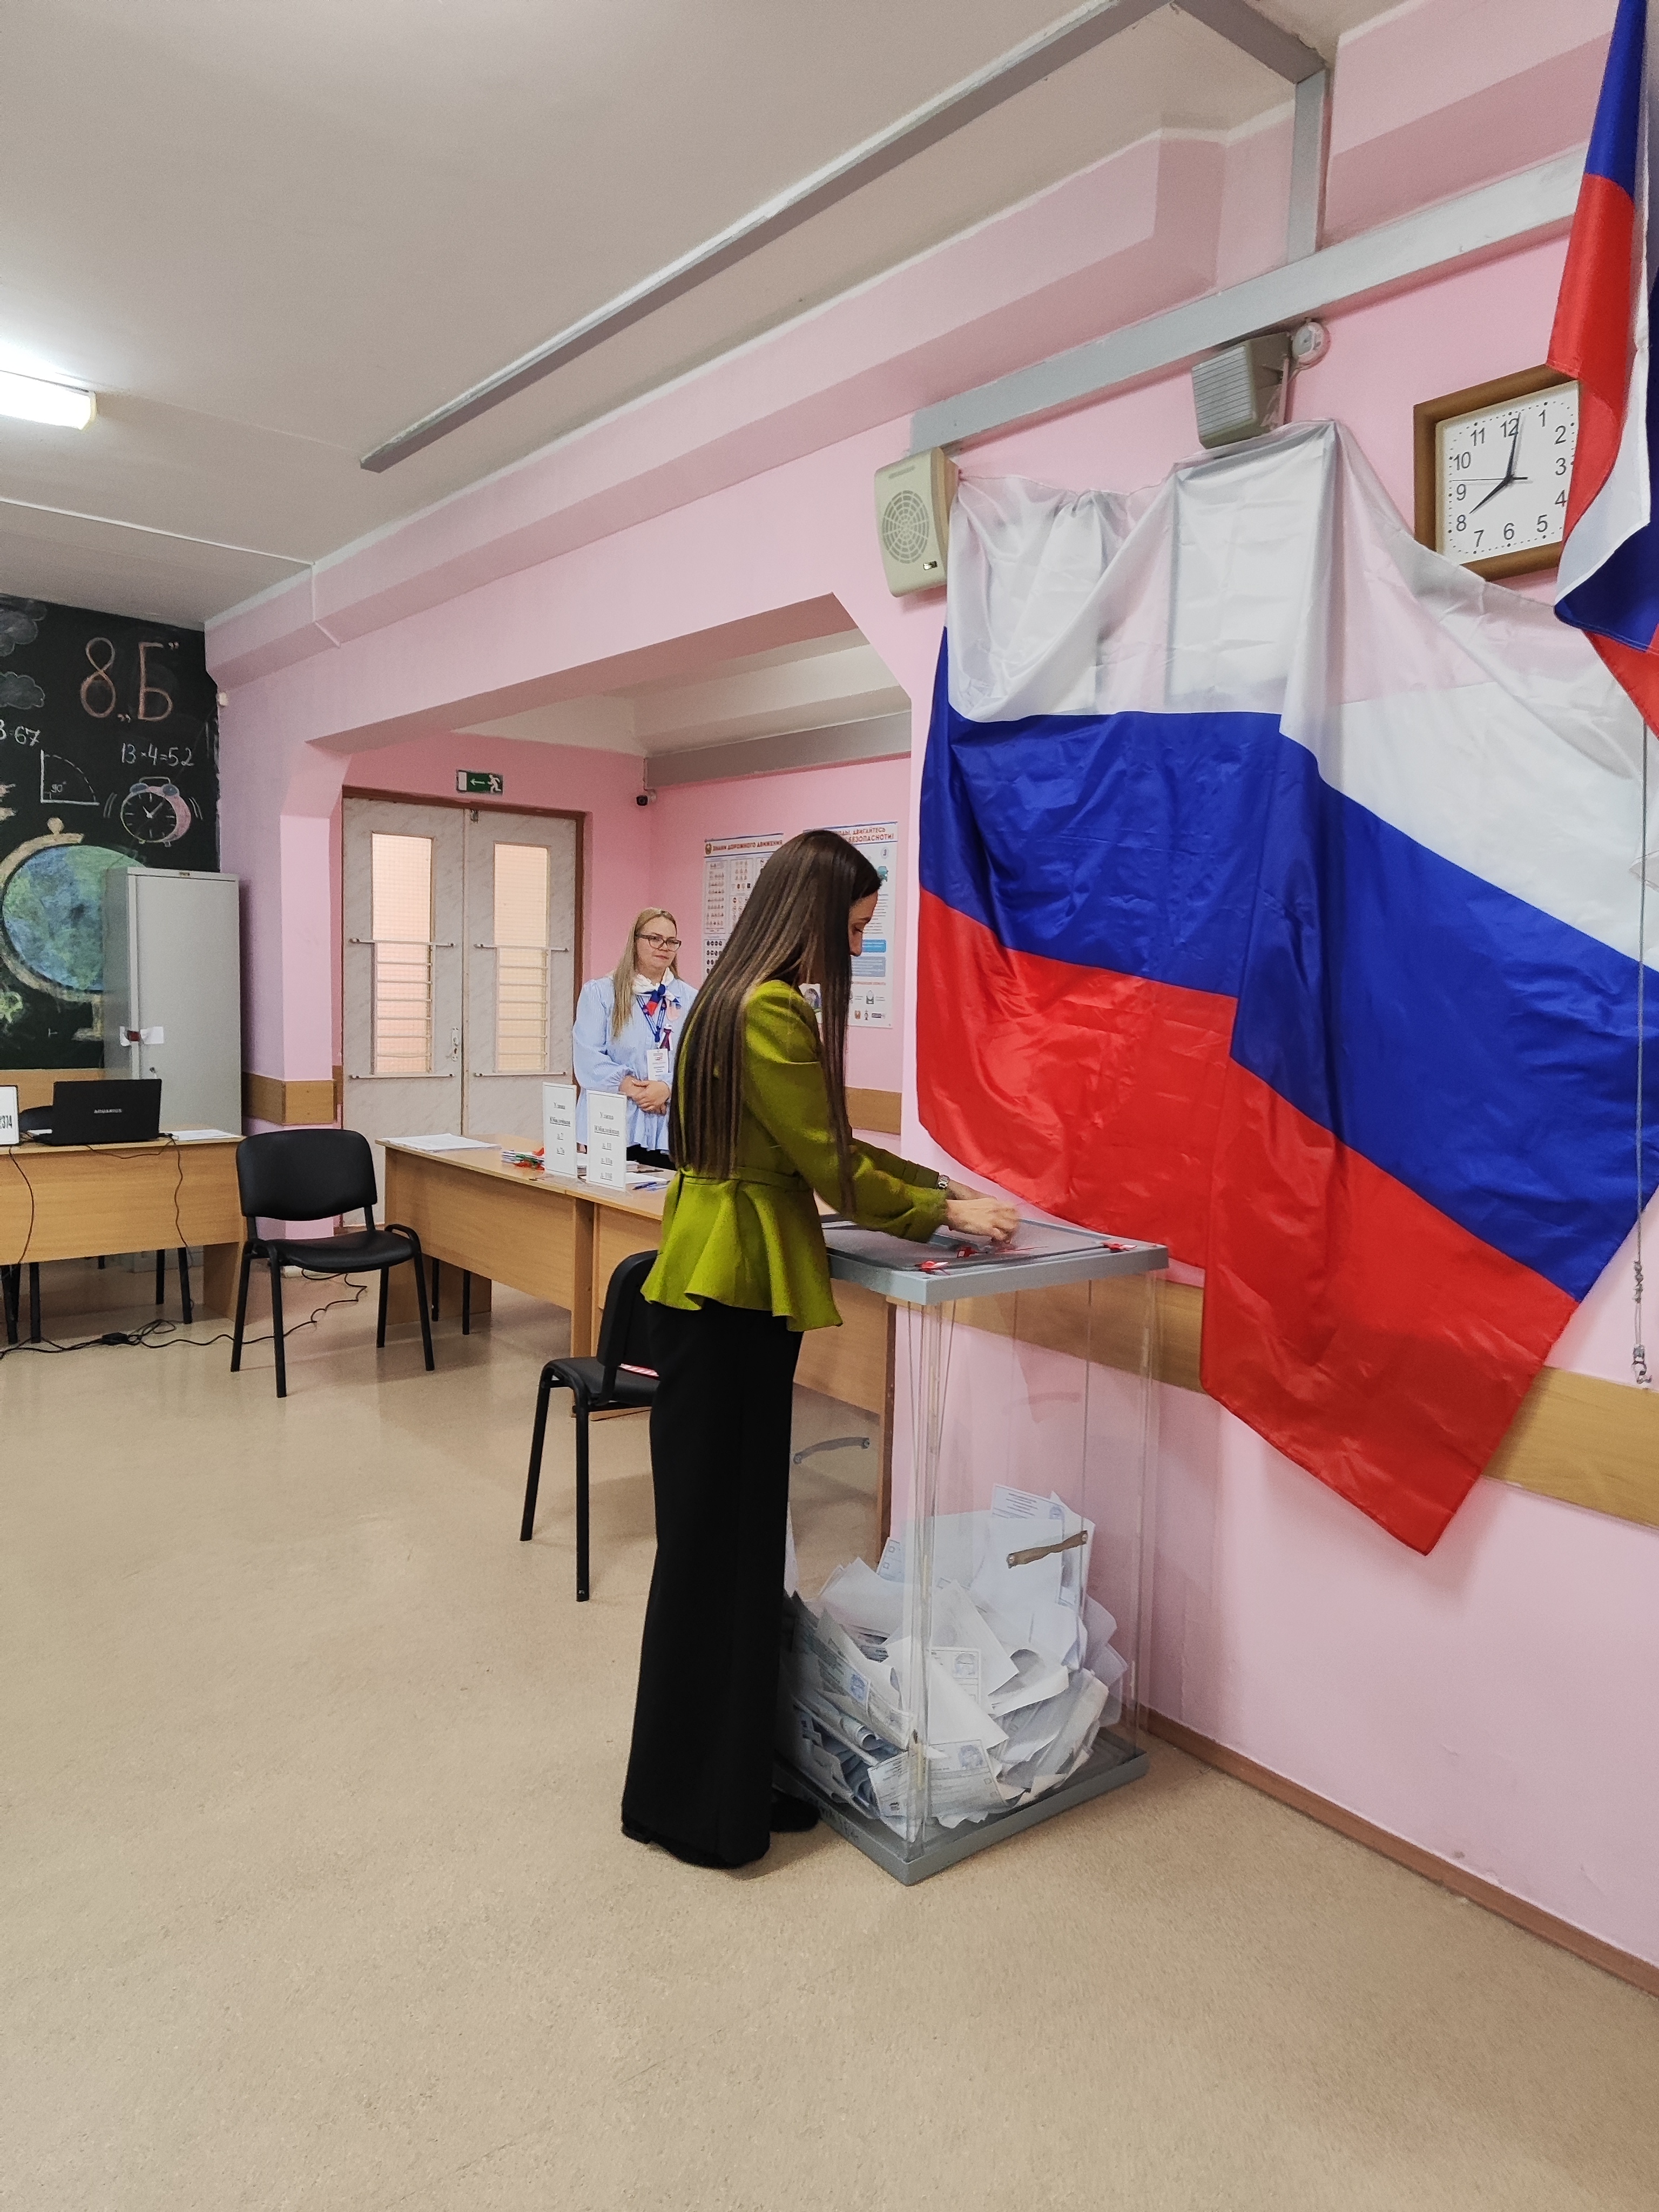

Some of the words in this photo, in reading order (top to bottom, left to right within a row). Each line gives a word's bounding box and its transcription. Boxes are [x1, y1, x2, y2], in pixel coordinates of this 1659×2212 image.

[1539, 409, 1546, 427] 1
[1471, 428, 1486, 446] 11
[1500, 418, 1519, 438] 12
[1554, 426, 1566, 444] 2
[1454, 452, 1471, 470] 10
[1555, 458, 1566, 476] 3
[1456, 484, 1466, 501] 9
[1555, 490, 1567, 507] 4
[1456, 514, 1467, 531] 8
[1503, 523, 1514, 540] 6
[1536, 514, 1548, 532] 5
[1474, 529, 1484, 548] 7
